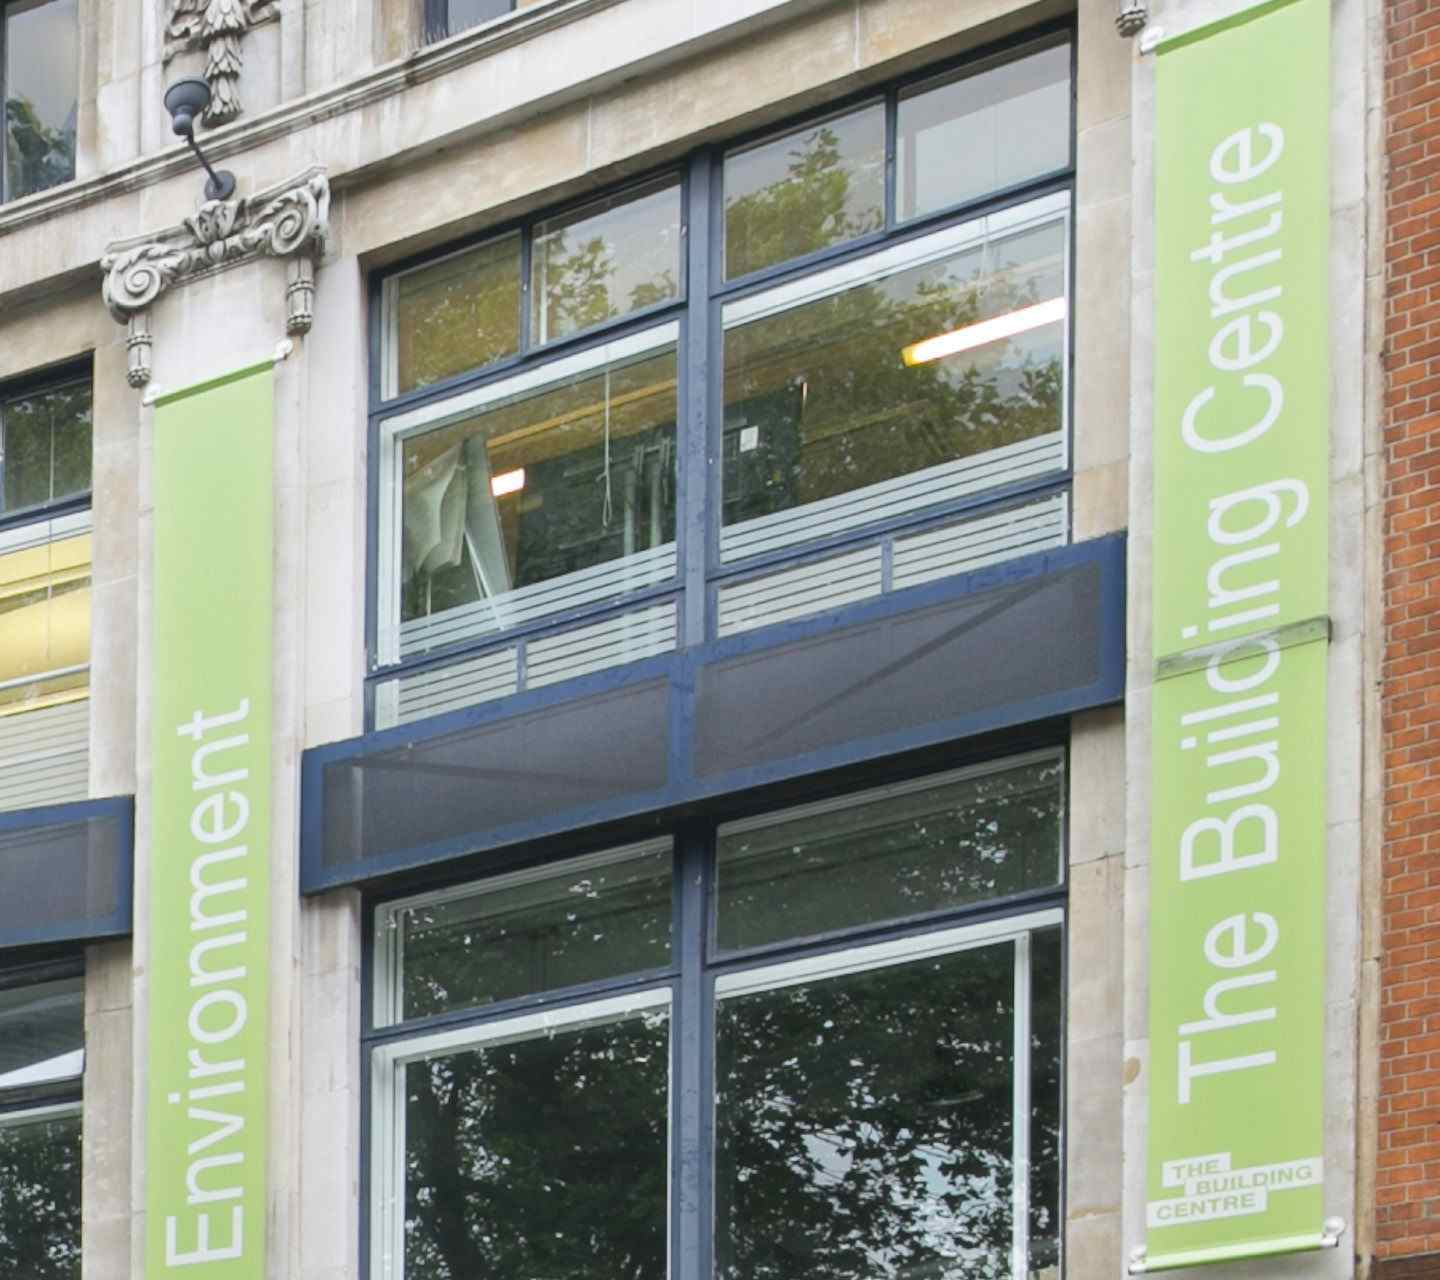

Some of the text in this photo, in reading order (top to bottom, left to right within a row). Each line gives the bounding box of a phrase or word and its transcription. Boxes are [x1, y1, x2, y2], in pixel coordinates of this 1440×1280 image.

[1178, 120, 1309, 1105] The Building Centre
[164, 697, 251, 1269] Environment
[1172, 1158, 1221, 1180] THE
[1196, 1165, 1313, 1196] BUILDING
[1156, 1192, 1257, 1220] CENTRE
